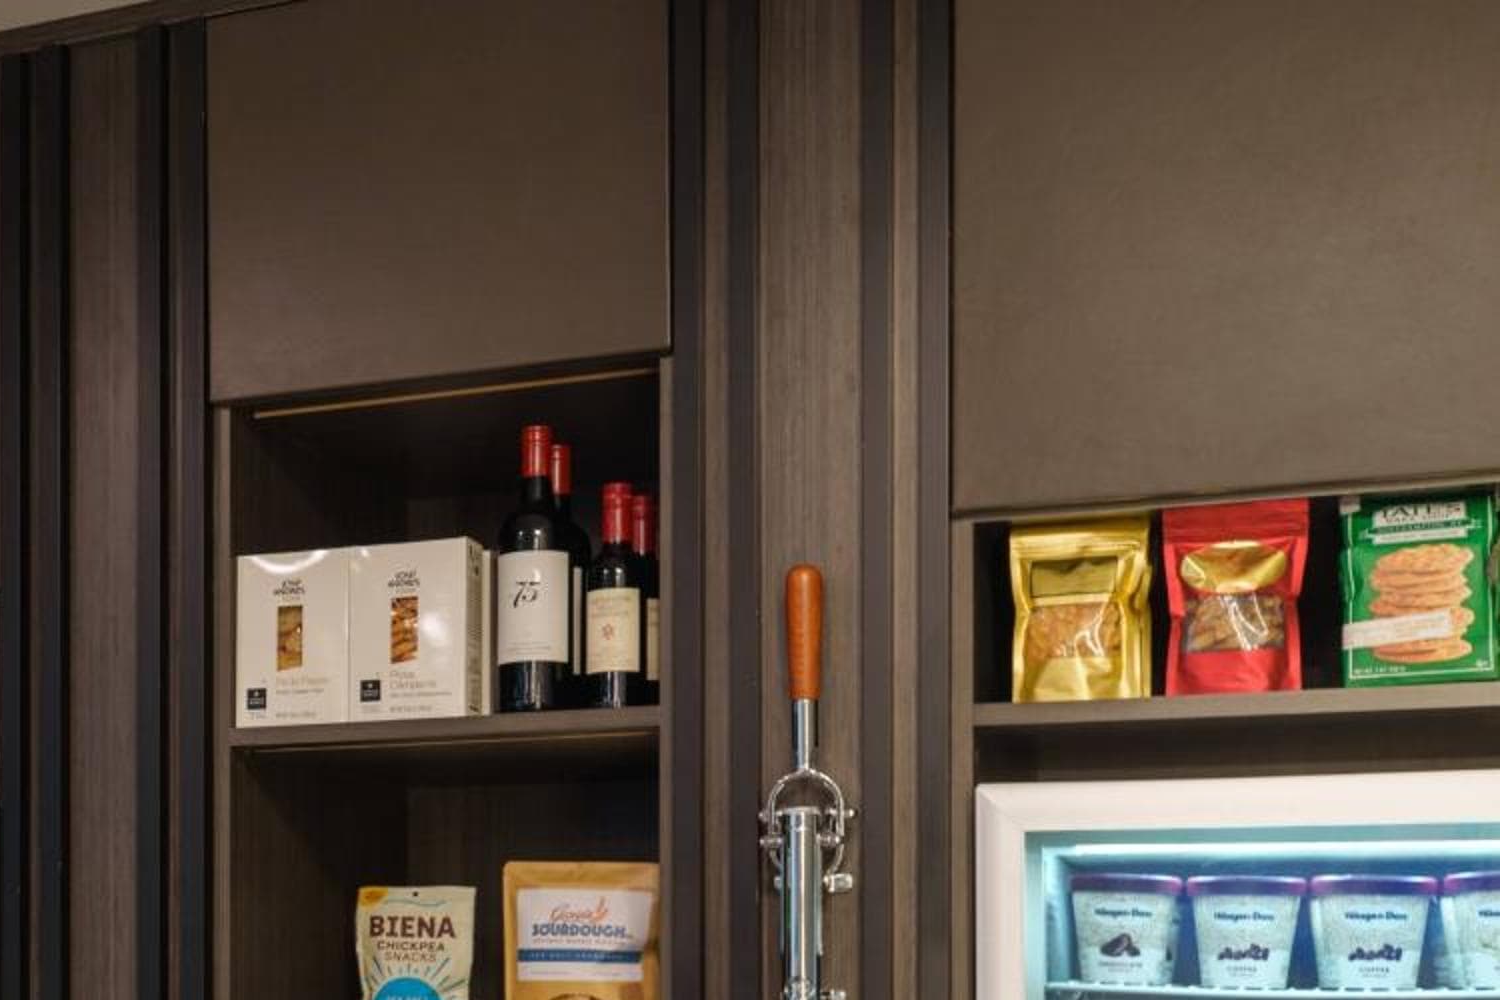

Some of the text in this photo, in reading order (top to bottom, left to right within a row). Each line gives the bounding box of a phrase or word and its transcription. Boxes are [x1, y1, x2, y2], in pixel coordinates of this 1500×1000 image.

[512, 580, 542, 609] 75
[369, 915, 456, 939] BIENA
[531, 923, 627, 938] SOURDOUGH
[377, 940, 445, 952] CHICKPEA
[384, 951, 437, 962] SNACKS
